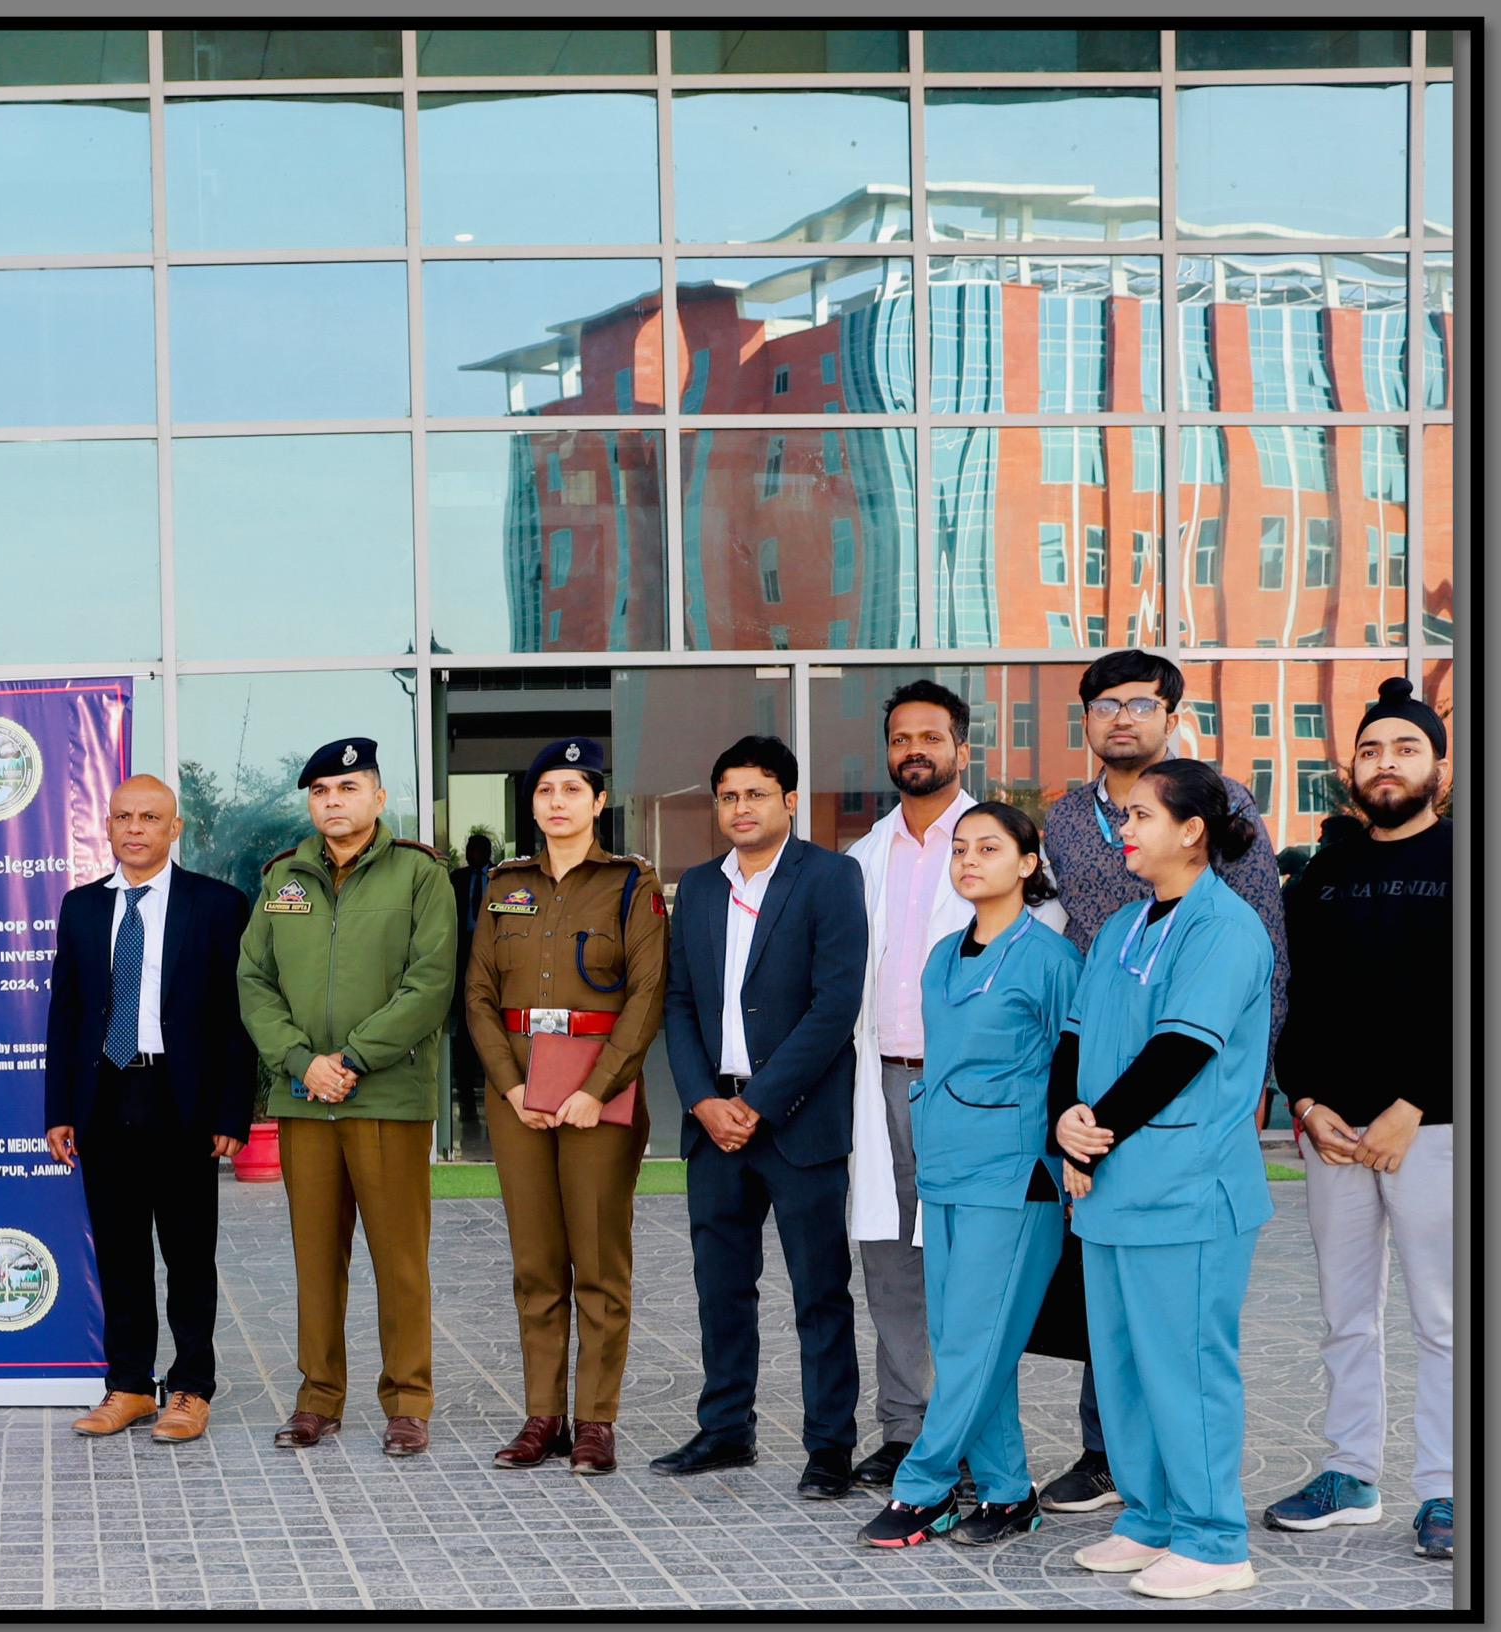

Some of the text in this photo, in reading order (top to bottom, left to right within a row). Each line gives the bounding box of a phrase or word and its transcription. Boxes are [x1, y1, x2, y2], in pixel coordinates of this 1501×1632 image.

[33, 919, 56, 931] on
[0, 978, 39, 992] 2024,
[16, 1059, 37, 1070] and
[7, 1138, 51, 1153] MEDICIN
[30, 1164, 72, 1176] JAMMU
